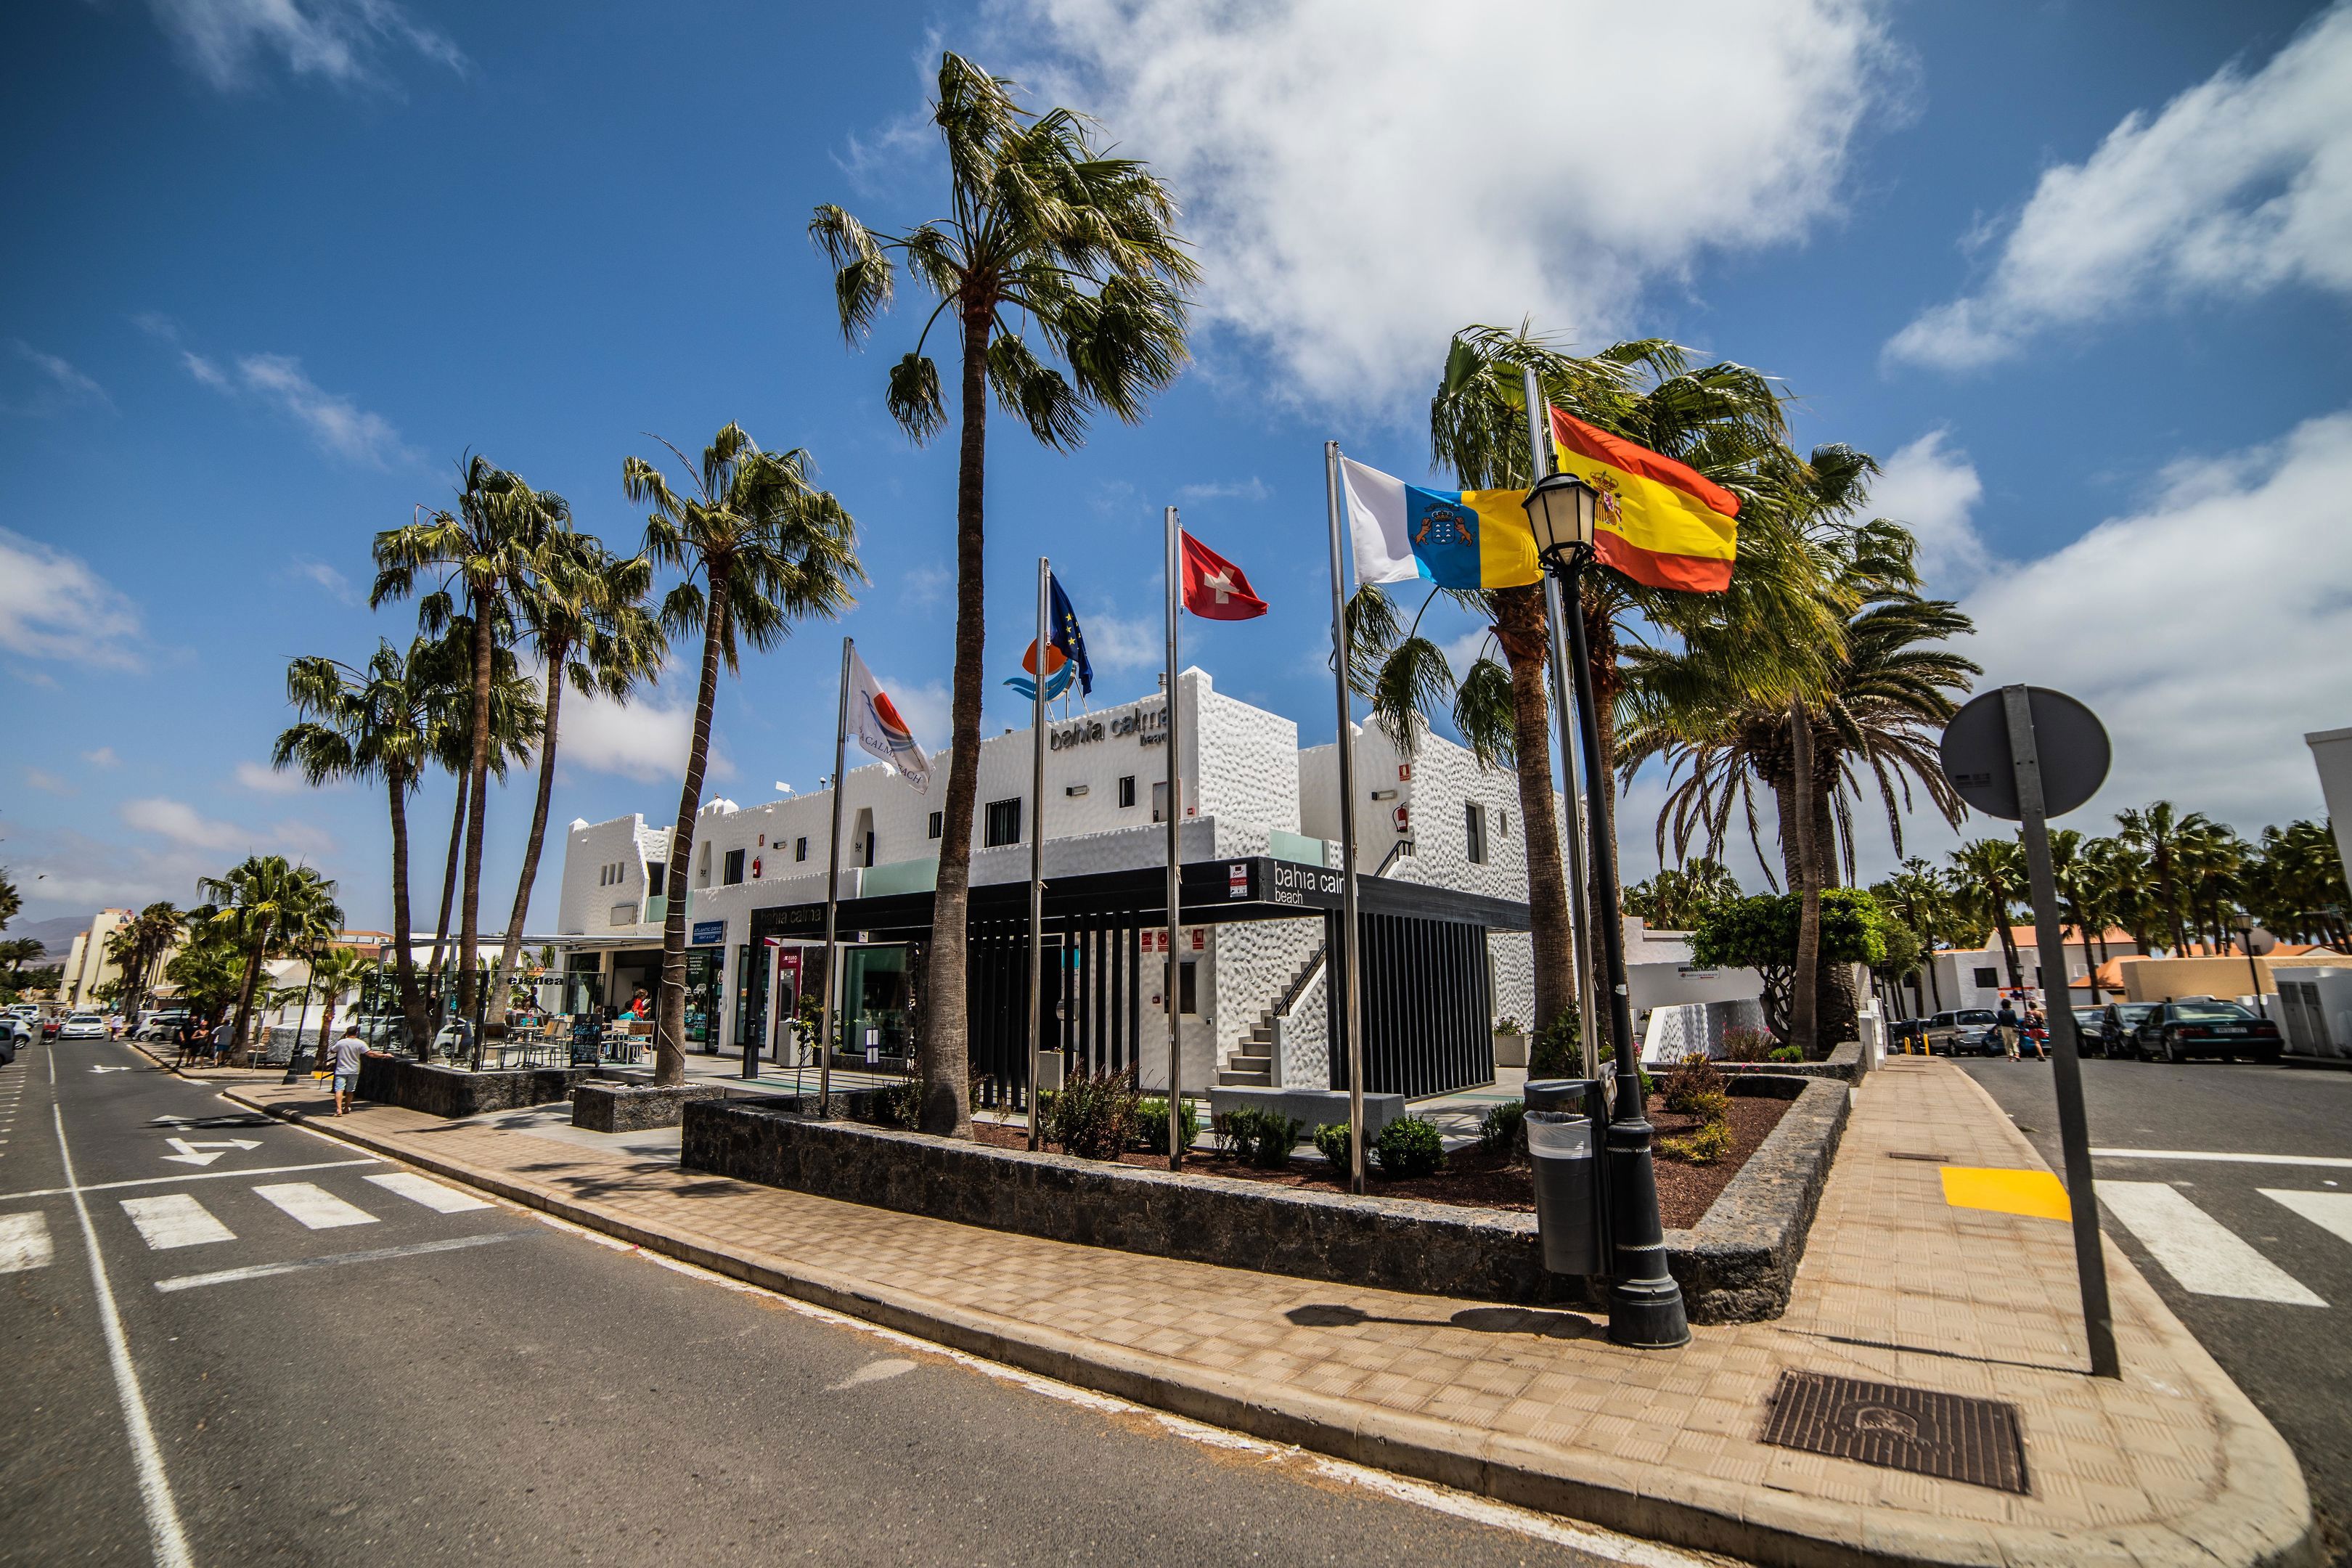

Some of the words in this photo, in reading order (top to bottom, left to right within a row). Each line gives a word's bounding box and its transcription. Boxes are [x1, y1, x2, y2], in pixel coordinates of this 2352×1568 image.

[1050, 719, 1105, 750] bahia
[1140, 731, 1167, 746] beac
[1274, 860, 1316, 891] bahia
[1274, 886, 1304, 905] beach
[790, 905, 822, 923] calma
